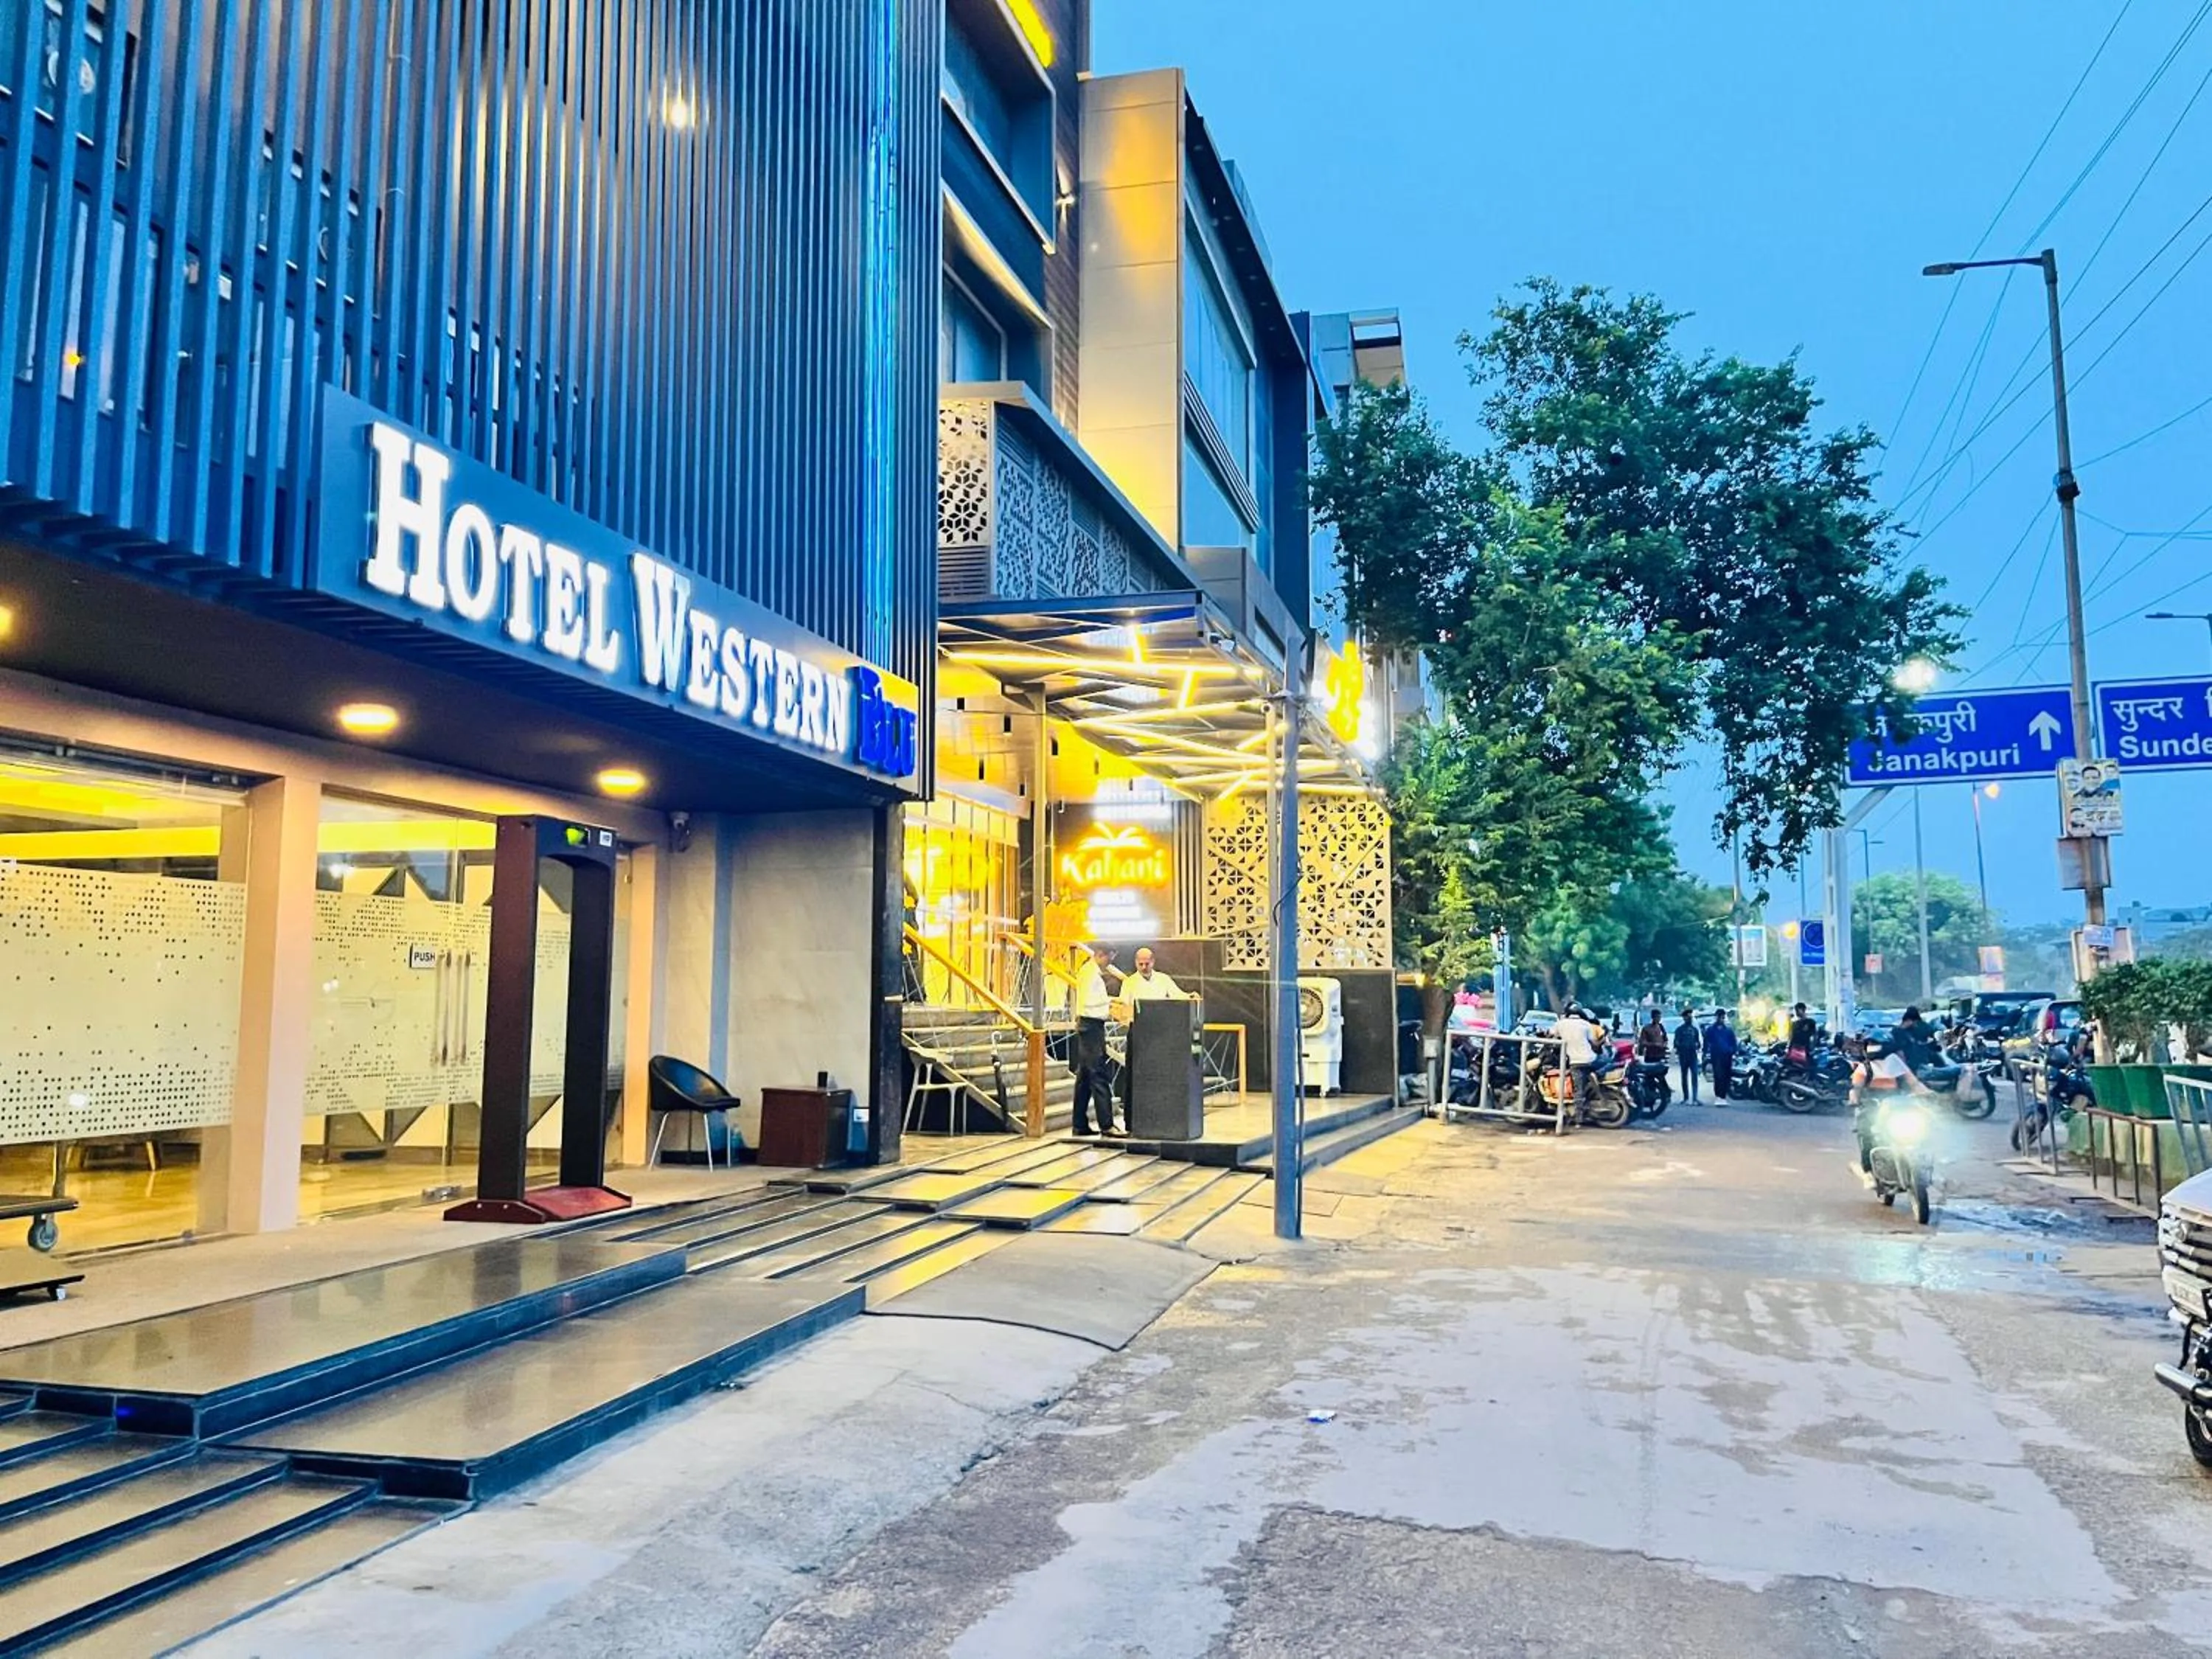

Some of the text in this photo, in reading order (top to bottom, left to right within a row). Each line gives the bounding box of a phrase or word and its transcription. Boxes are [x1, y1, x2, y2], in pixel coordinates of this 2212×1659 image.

[365, 421, 619, 674] HOTEL
[631, 552, 849, 754] WESTERN
[2110, 697, 2183, 732] सुन्दर
[1868, 743, 2020, 773] Janakpuri
[414, 952, 436, 962] PUSH
